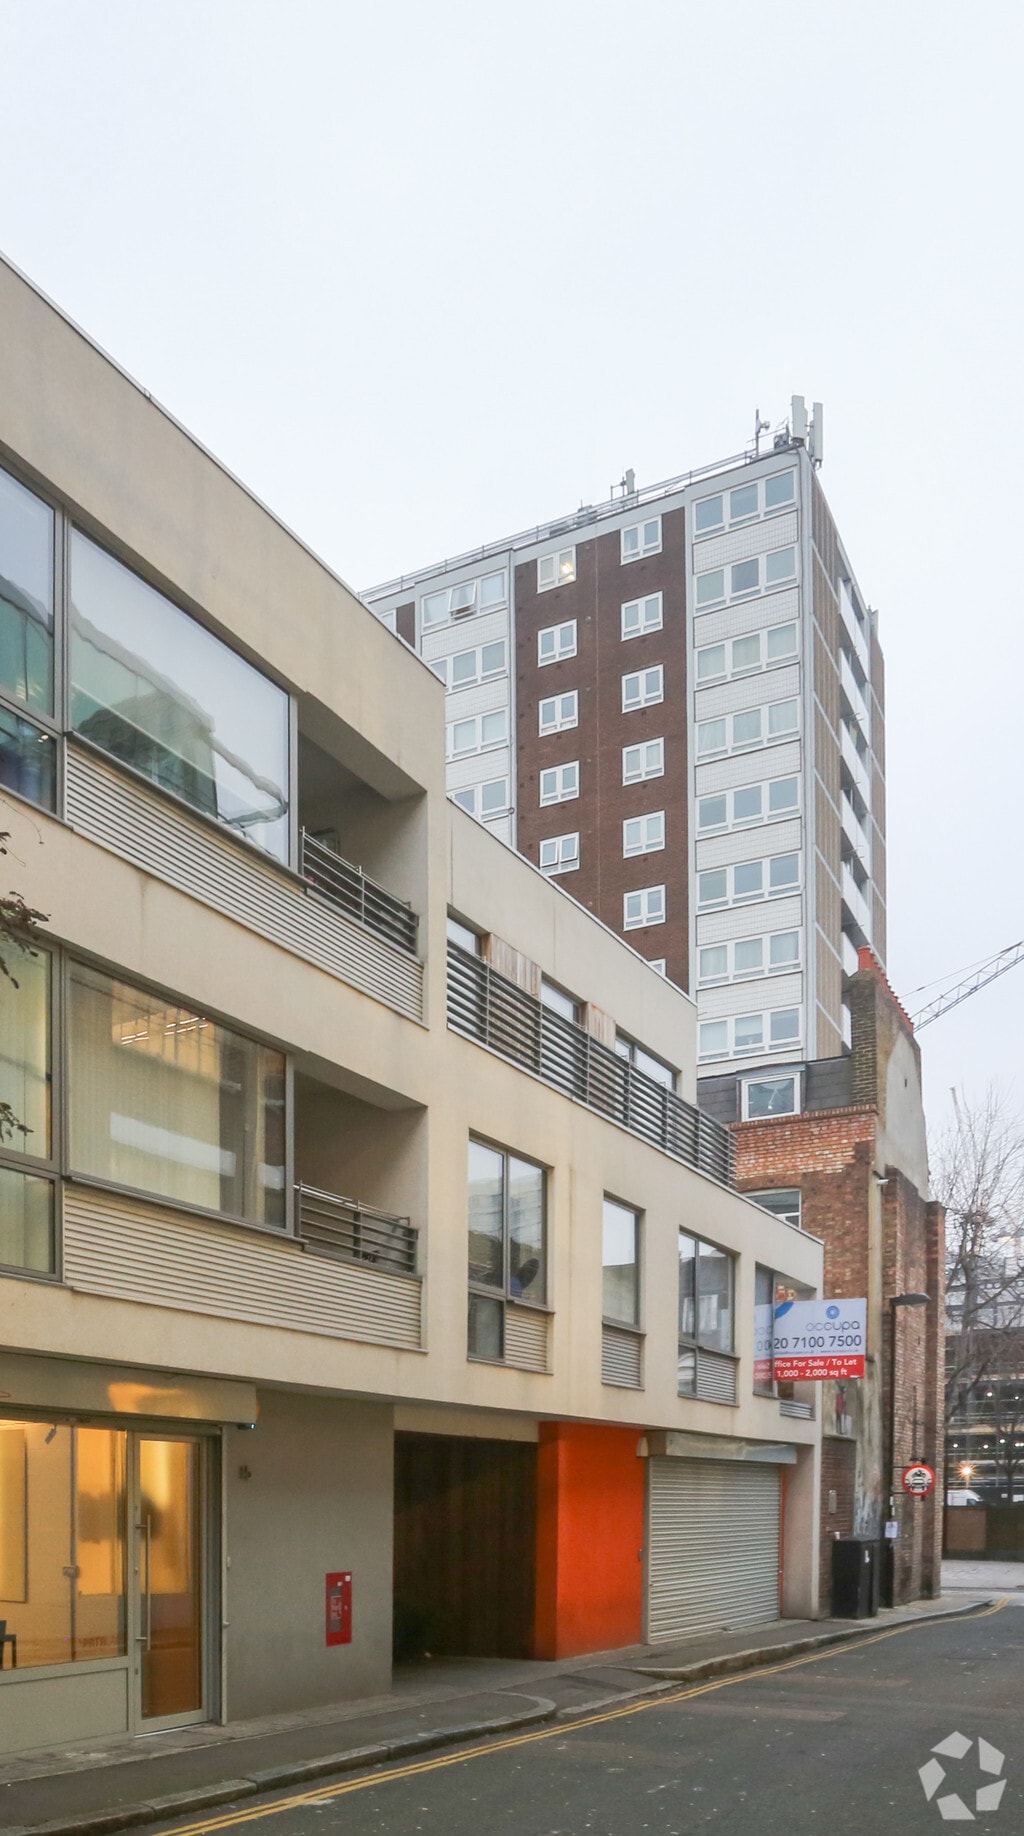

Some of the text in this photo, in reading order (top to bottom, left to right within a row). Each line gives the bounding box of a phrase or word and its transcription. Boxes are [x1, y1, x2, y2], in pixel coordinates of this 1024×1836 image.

[792, 1336, 825, 1348] 7100
[828, 1335, 862, 1347] 7500
[808, 1359, 825, 1367] Sale
[832, 1358, 842, 1366] To
[844, 1358, 857, 1366] Let
[805, 1369, 828, 1377] 2,000
[841, 1367, 848, 1375] ft
